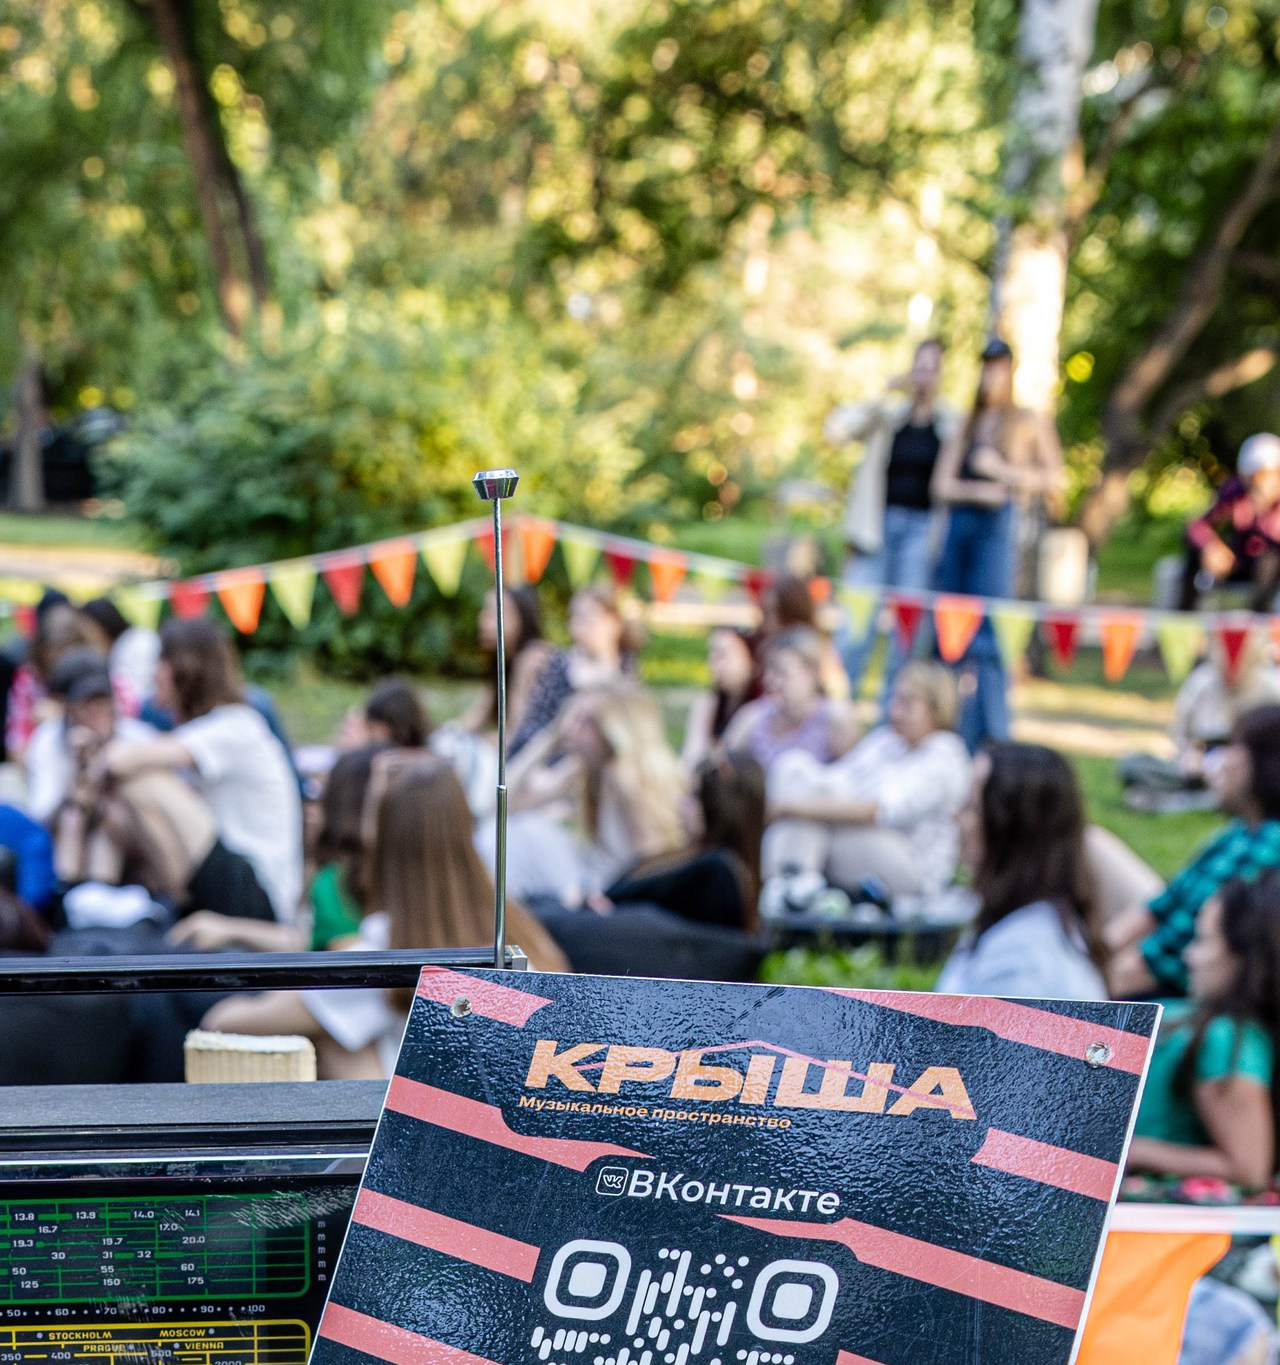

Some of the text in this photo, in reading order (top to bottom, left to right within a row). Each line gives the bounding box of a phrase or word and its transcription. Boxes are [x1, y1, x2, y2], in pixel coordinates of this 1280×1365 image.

[524, 1039, 978, 1121] КРЫША
[519, 1095, 793, 1129] Музыкальное пространство
[627, 1169, 841, 1214] ВКонтакте
[14, 1212, 35, 1221] 13.8
[75, 1211, 97, 1220] 13.9
[133, 1210, 155, 1219] 14.0
[184, 1209, 201, 1217] 14.1
[38, 1225, 59, 1234] 16.7
[12, 1239, 34, 1248] 19.3
[101, 1237, 124, 1246] 19.7
[181, 1235, 206, 1244] 20.0
[50, 1251, 66, 1260] 30
[102, 1250, 114, 1259] 31
[136, 1250, 152, 1259] 32
[11, 1267, 27, 1276] 50
[100, 1265, 115, 1274] 55
[180, 1263, 195, 1272] 60
[20, 1280, 40, 1289] 125
[102, 1278, 121, 1287] 150
[187, 1277, 205, 1285] 175
[6, 1309, 21, 1318] 50
[54, 1308, 69, 1317] 60
[103, 1306, 118, 1316] 70
[151, 1306, 167, 1315] 80
[200, 1305, 215, 1314] 90
[247, 1304, 266, 1313] 100
[48, 1331, 113, 1340] STOCKHOLM
[159, 1328, 206, 1338] MOSCOW
[82, 1343, 125, 1352] PRAGUE
[184, 1341, 225, 1350] VIENNA
[0, 1352, 22, 1361] 350
[50, 1351, 71, 1360] 400
